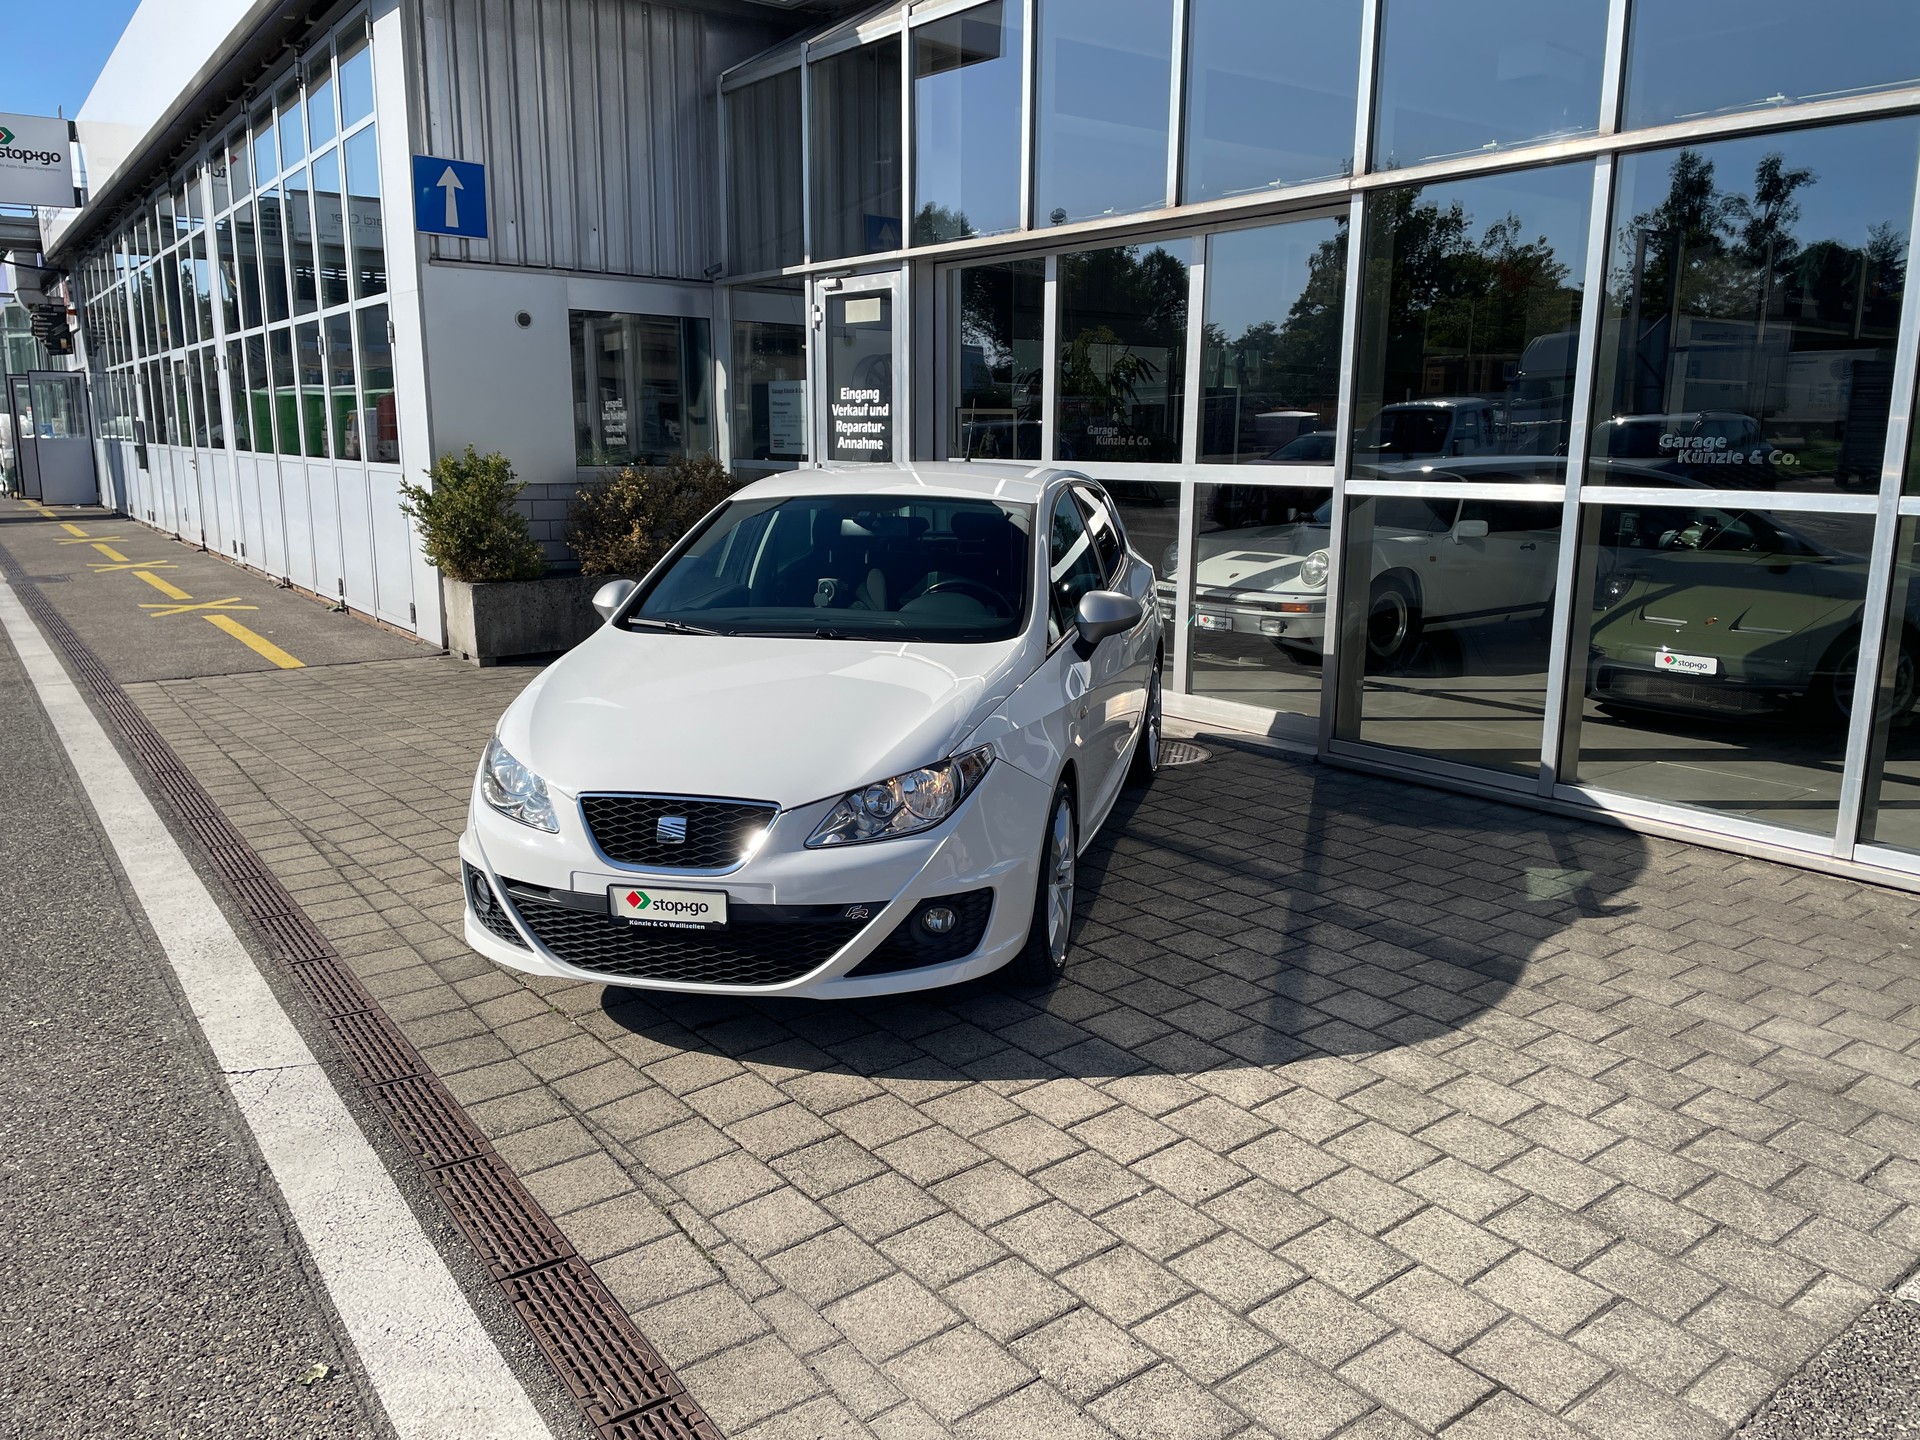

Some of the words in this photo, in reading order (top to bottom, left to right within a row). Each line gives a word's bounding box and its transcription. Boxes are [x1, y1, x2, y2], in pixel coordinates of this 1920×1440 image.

[840, 387, 880, 403] Eingang
[831, 403, 869, 416] Verkauf
[869, 403, 889, 416] und
[835, 420, 886, 436] Reparatur-
[1087, 425, 1118, 437] Garage
[837, 436, 884, 450] Annahme
[1095, 435, 1126, 446] Künzle
[1127, 435, 1135, 446] &
[1137, 435, 1152, 446] Co.
[1659, 433, 1728, 452] Garage
[1677, 449, 1744, 464] Künzle
[1748, 450, 1763, 465] &
[1768, 450, 1800, 465] Co.
[1678, 660, 1708, 670] stop+go
[652, 899, 709, 916] stop+go
[629, 919, 652, 927] Künzle
[669, 922, 706, 930] Wallisellen
